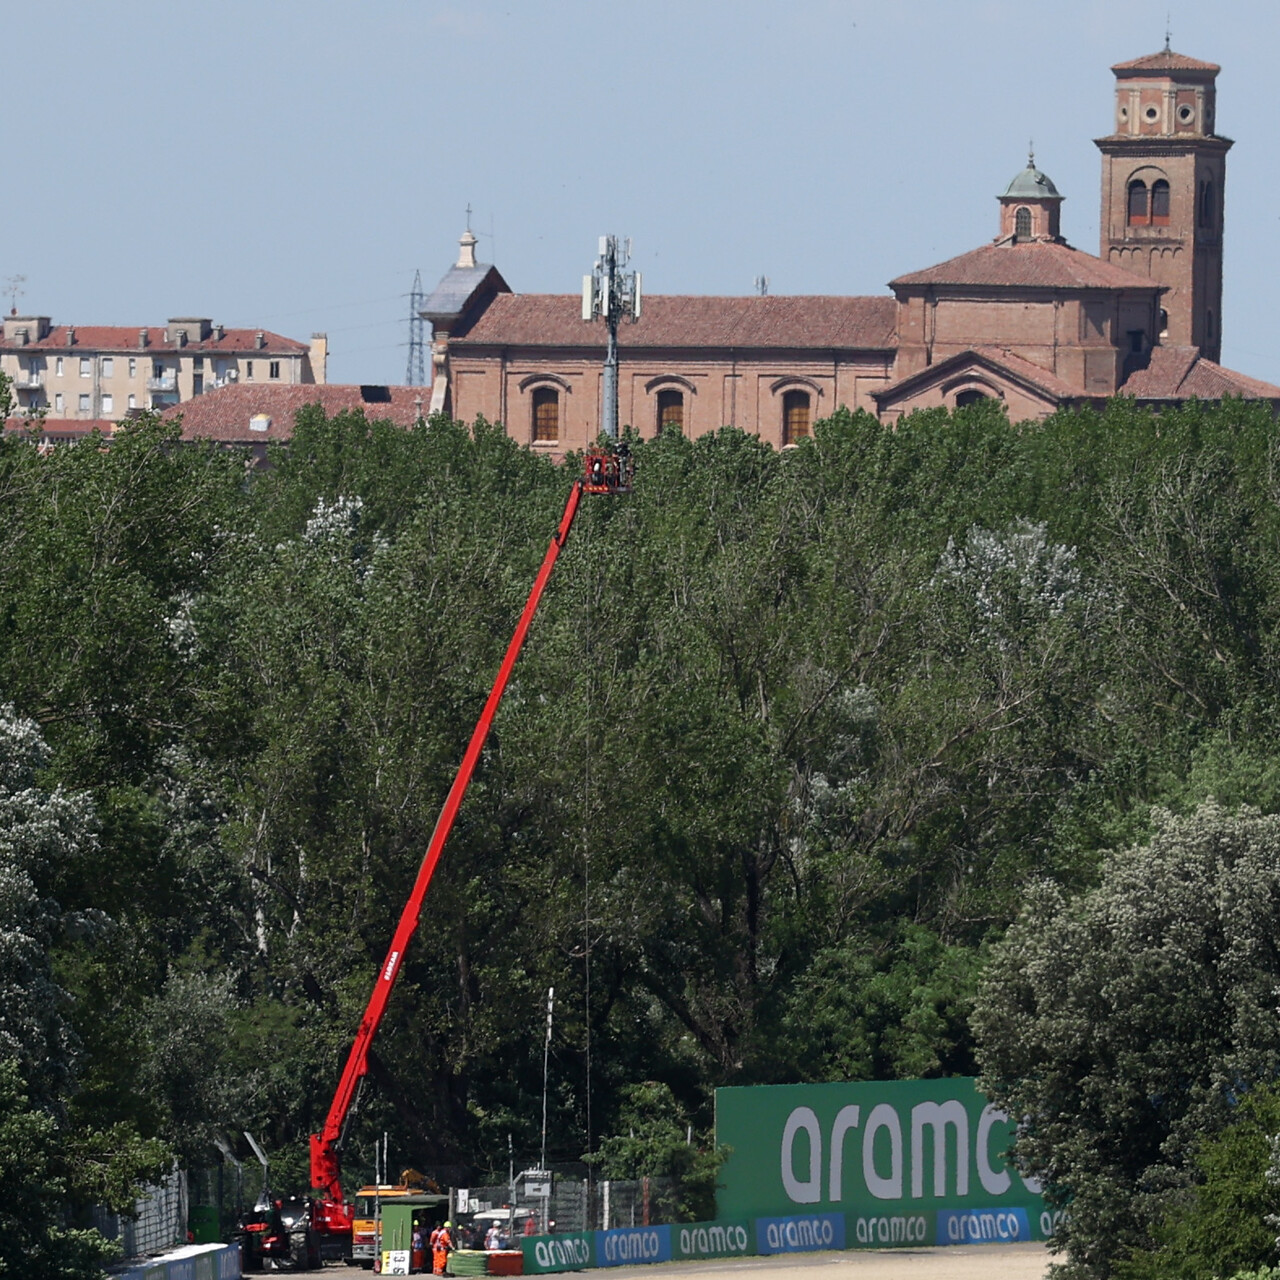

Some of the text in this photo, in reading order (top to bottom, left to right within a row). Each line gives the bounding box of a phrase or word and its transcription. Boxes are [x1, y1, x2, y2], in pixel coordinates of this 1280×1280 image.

[781, 1099, 1043, 1204] aramc
[680, 1225, 747, 1254] aramco
[767, 1219, 833, 1249] aramco
[856, 1216, 926, 1243] aramco
[948, 1213, 1019, 1240] aramco
[535, 1238, 589, 1266] aramco
[604, 1231, 659, 1262] aramco
